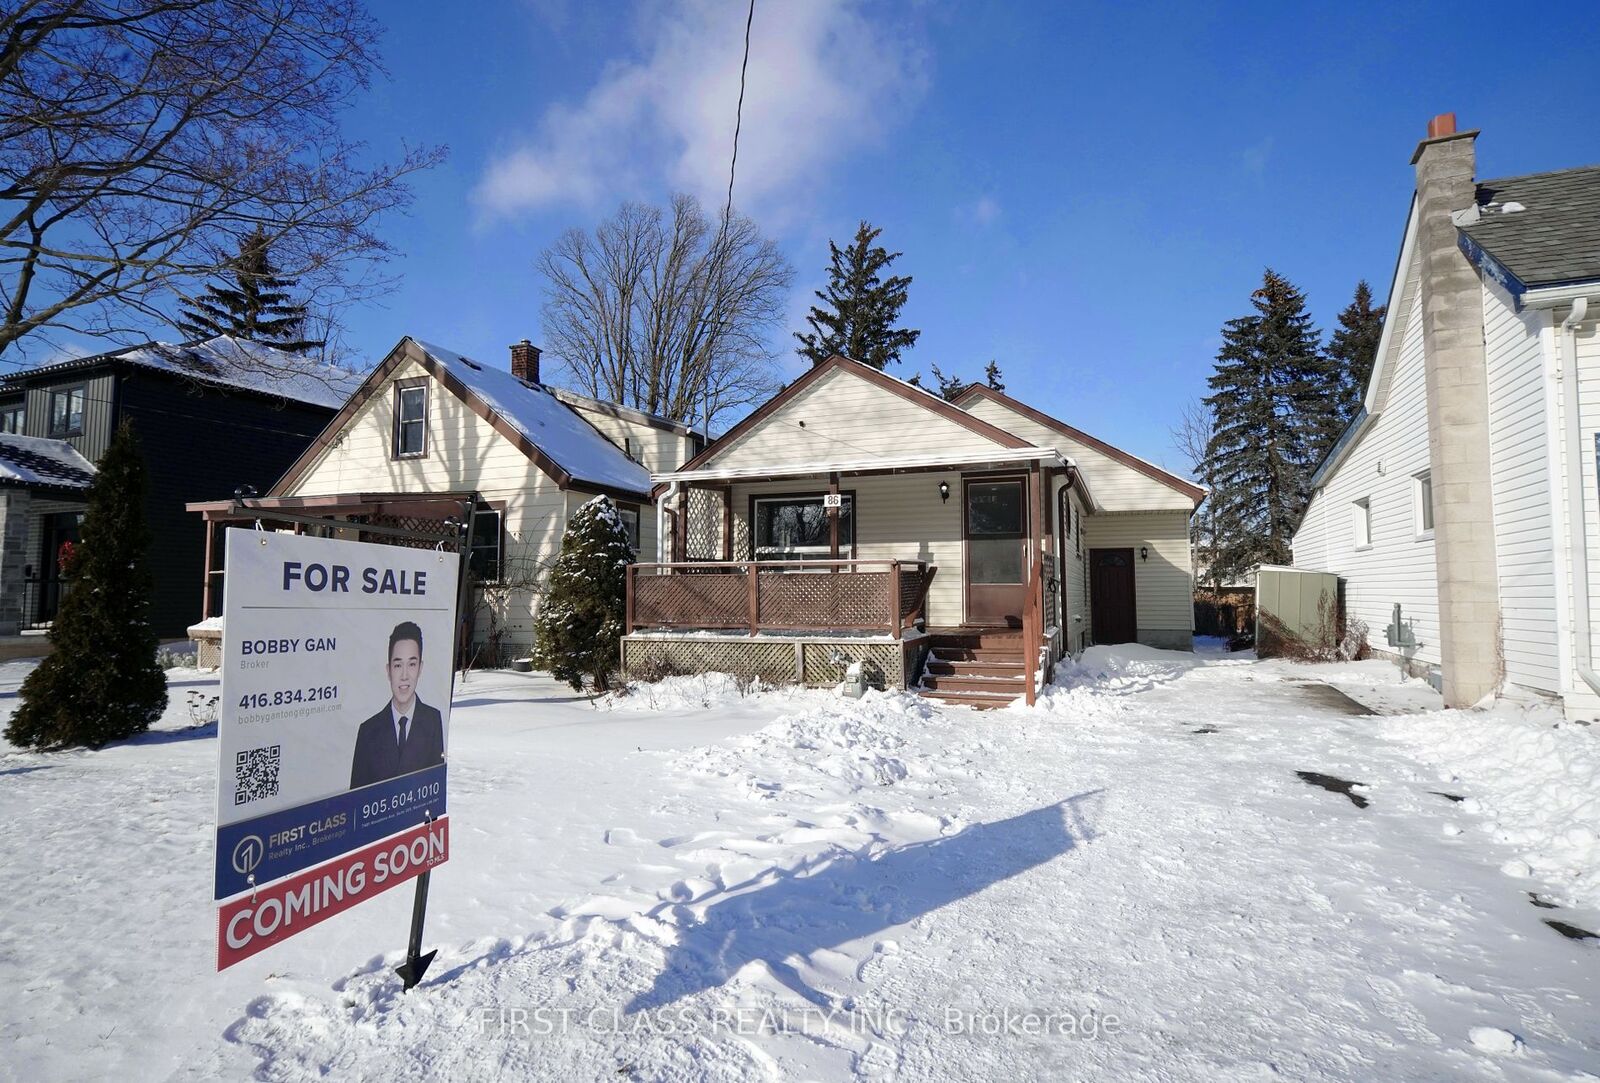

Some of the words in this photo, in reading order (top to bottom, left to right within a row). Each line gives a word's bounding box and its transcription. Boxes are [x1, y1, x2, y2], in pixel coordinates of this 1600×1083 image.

[827, 495, 839, 505] 86
[283, 561, 350, 593] FOR
[361, 567, 426, 595] SALE
[241, 639, 300, 655] BOBBY
[304, 637, 336, 652] GAN
[240, 659, 269, 669] Broker
[239, 685, 338, 710] 416.834.2161
[362, 782, 439, 819] 905.604.1010
[269, 825, 306, 849] FIRST
[308, 812, 347, 835] CLASS
[268, 847, 293, 860] Realty
[226, 862, 366, 949] COMING
[374, 828, 445, 883] SOON
